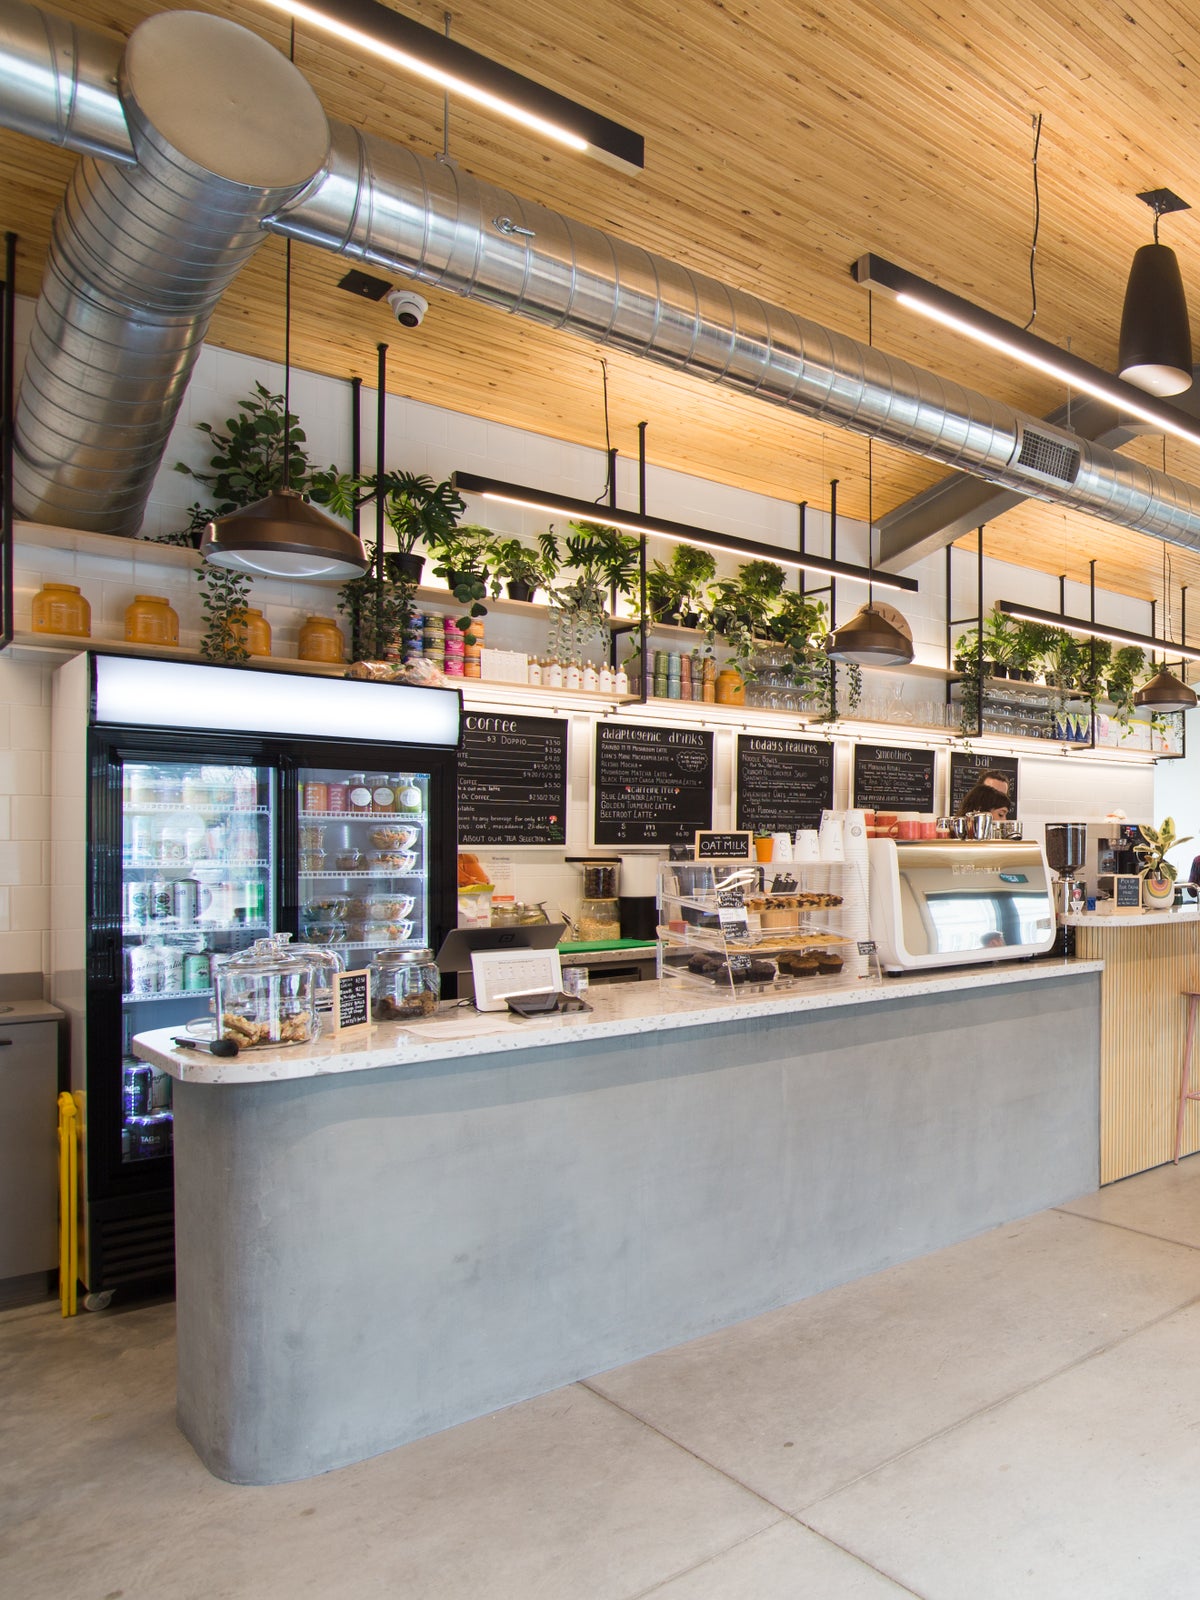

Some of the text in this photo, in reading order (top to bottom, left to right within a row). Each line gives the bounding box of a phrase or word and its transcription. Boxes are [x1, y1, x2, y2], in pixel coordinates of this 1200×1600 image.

[466, 716, 517, 732] Coffee
[602, 728, 704, 746] adaptogenic drinks
[750, 738, 818, 755] today's features
[975, 755, 993, 768] bar
[600, 800, 625, 810] GOLDEN
[655, 802, 673, 811] LATTE
[600, 809, 653, 819] BEETROOT LATTE
[463, 834, 485, 843] ABOUT
[504, 834, 517, 843] TEA
[701, 841, 747, 850] OAT MILK
